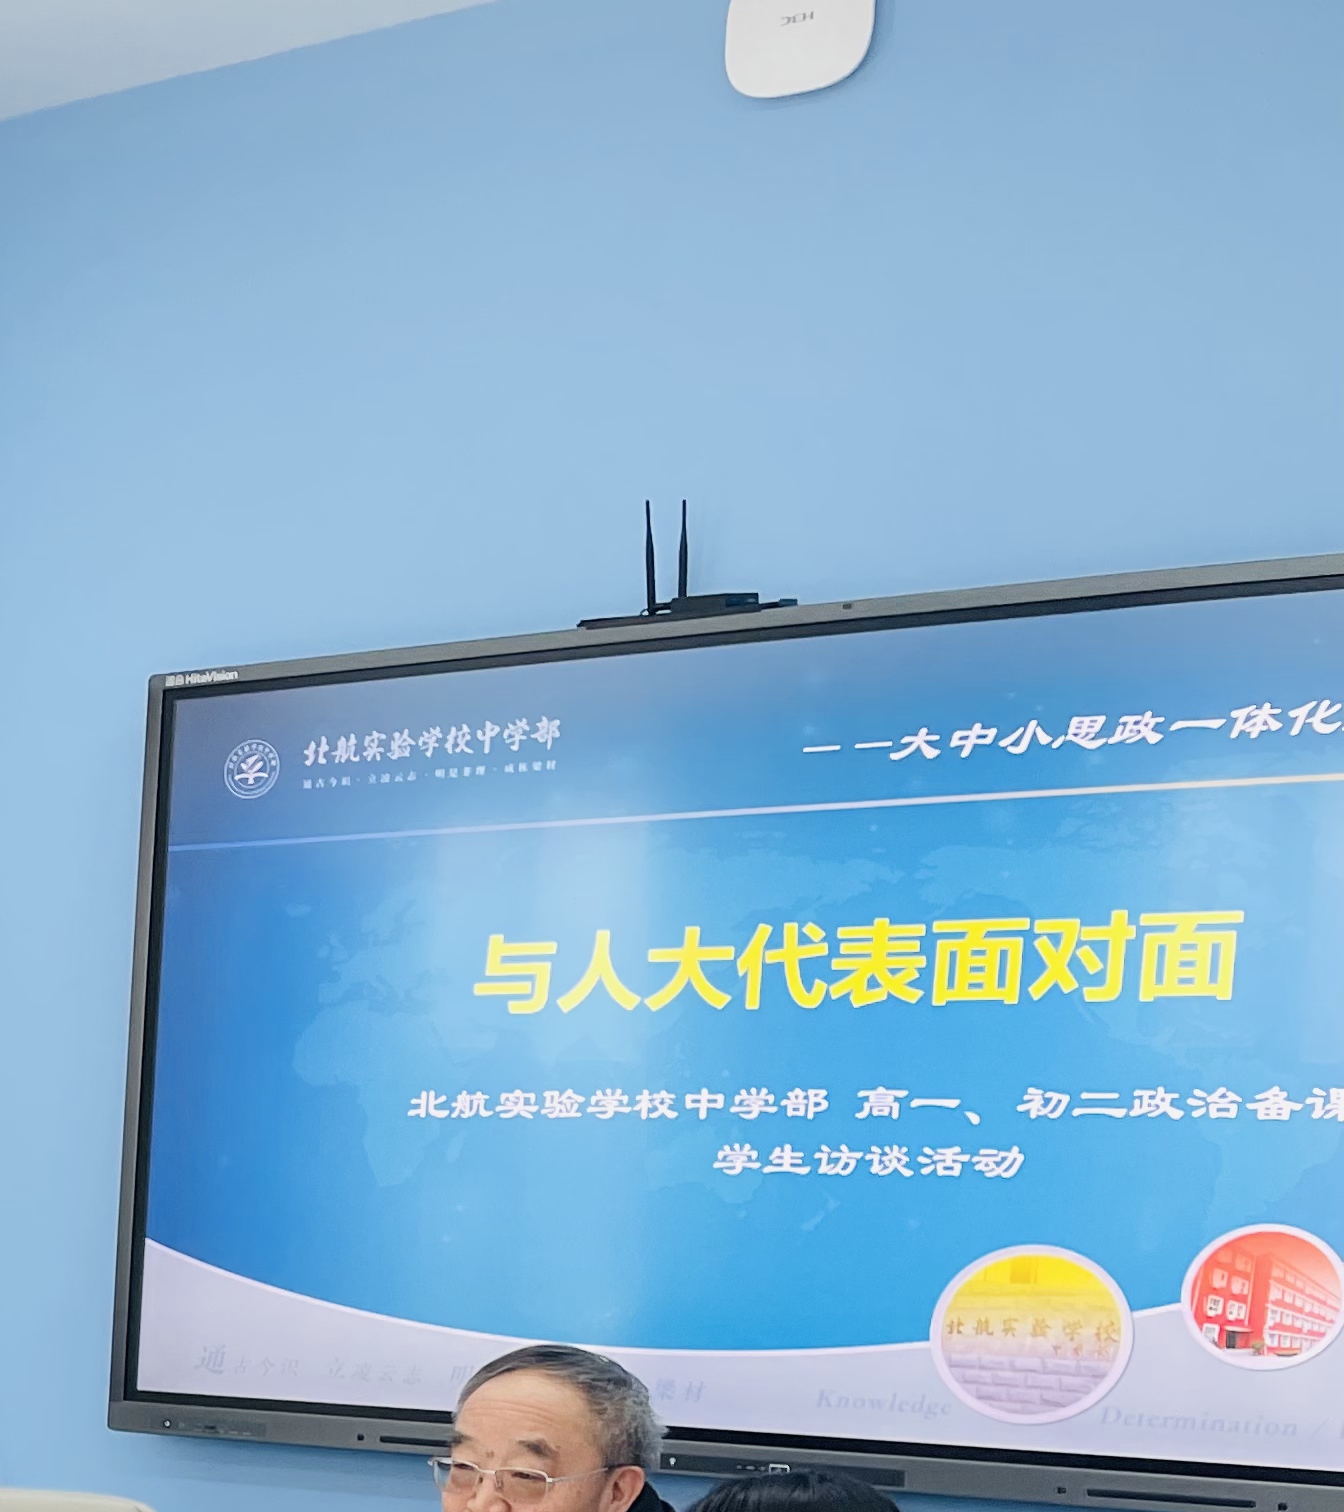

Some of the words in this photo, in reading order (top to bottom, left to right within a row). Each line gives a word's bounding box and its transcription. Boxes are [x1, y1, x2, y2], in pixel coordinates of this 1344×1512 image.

[303, 715, 561, 767] 北航实验学校中学部
[472, 909, 1246, 1015] 与人大代表面对面
[407, 1087, 830, 1120] 北航实验学校中学部
[713, 1142, 1026, 1178] 学生访谈活动
[946, 1316, 1119, 1343] 北航实验学校
[815, 1389, 953, 1420] Knowledge
[1101, 1405, 1298, 1437] Determination
